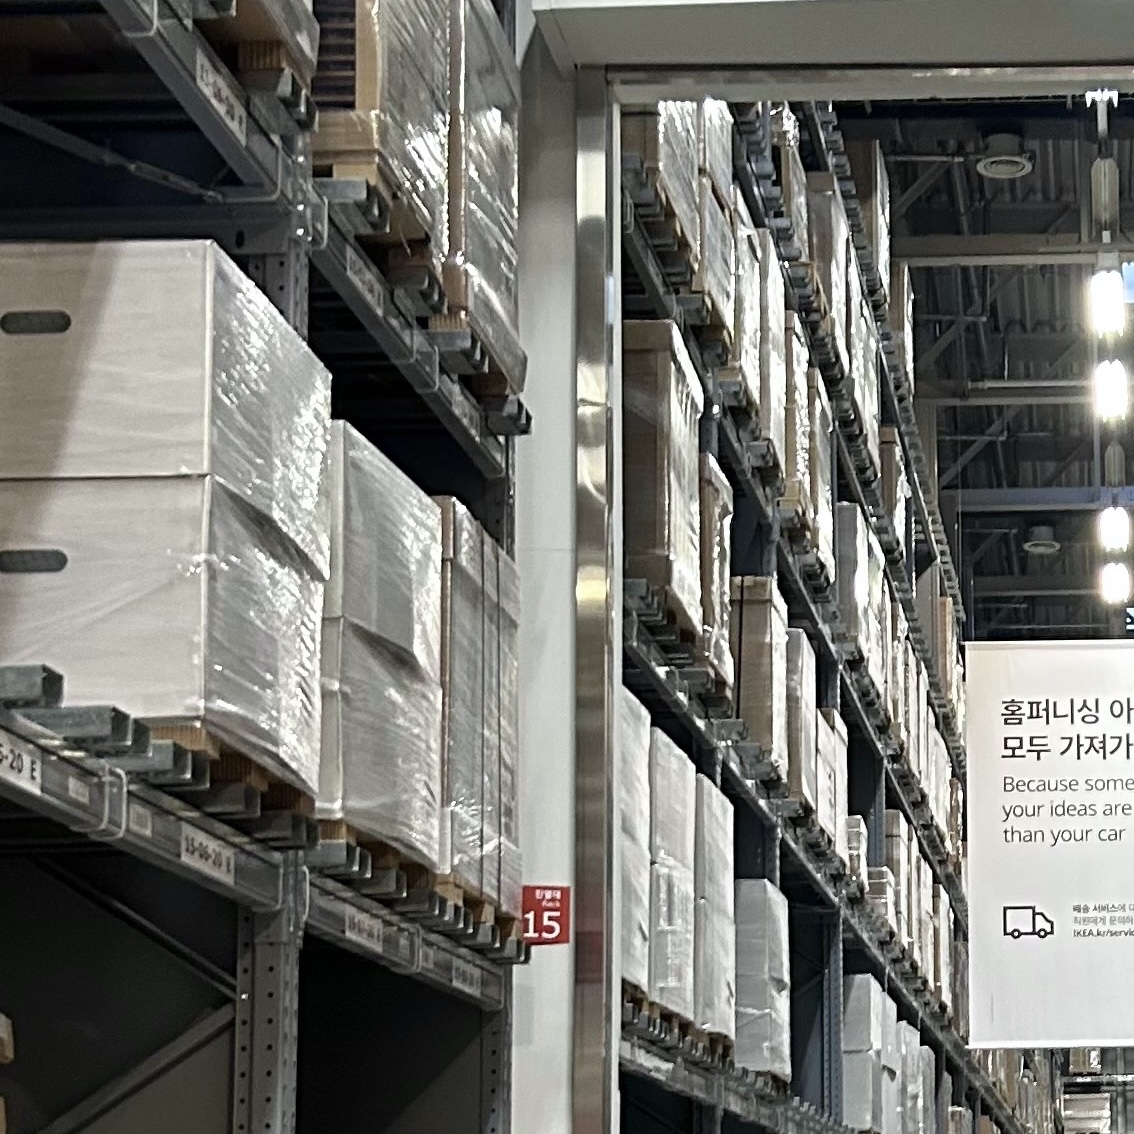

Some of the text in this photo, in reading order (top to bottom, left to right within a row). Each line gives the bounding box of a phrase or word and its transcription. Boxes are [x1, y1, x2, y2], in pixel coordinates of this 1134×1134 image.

[1000, 698, 1100, 725] 홈퍼니싱
[1001, 735, 1051, 761] 모두
[30, 760, 37, 780] E
[1003, 776, 1079, 793] Because
[1002, 802, 1045, 822] your
[1050, 799, 1098, 817] ideas
[1102, 803, 1132, 816] are
[1003, 825, 1126, 847] than your car
[523, 910, 561, 939] 15
